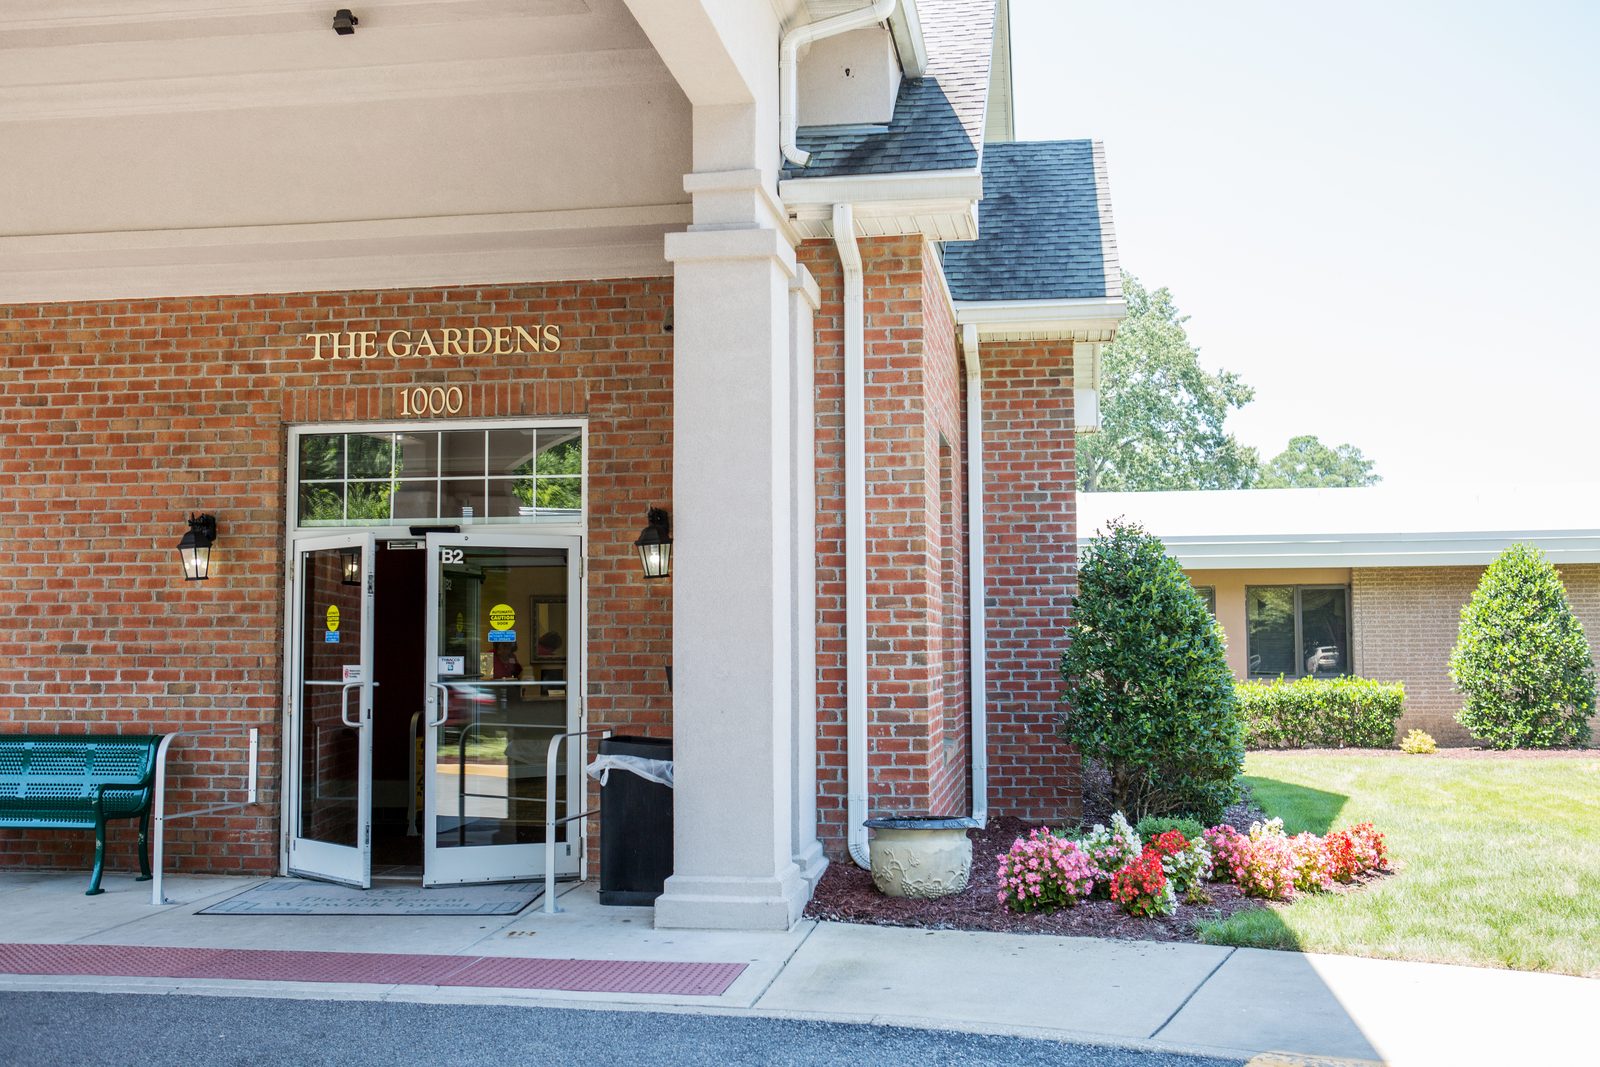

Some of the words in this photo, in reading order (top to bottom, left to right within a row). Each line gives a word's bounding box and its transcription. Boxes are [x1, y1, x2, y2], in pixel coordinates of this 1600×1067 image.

[306, 331, 379, 361] THE
[387, 324, 561, 358] GARDENS
[400, 386, 463, 416] 1000
[441, 549, 464, 564] B2
